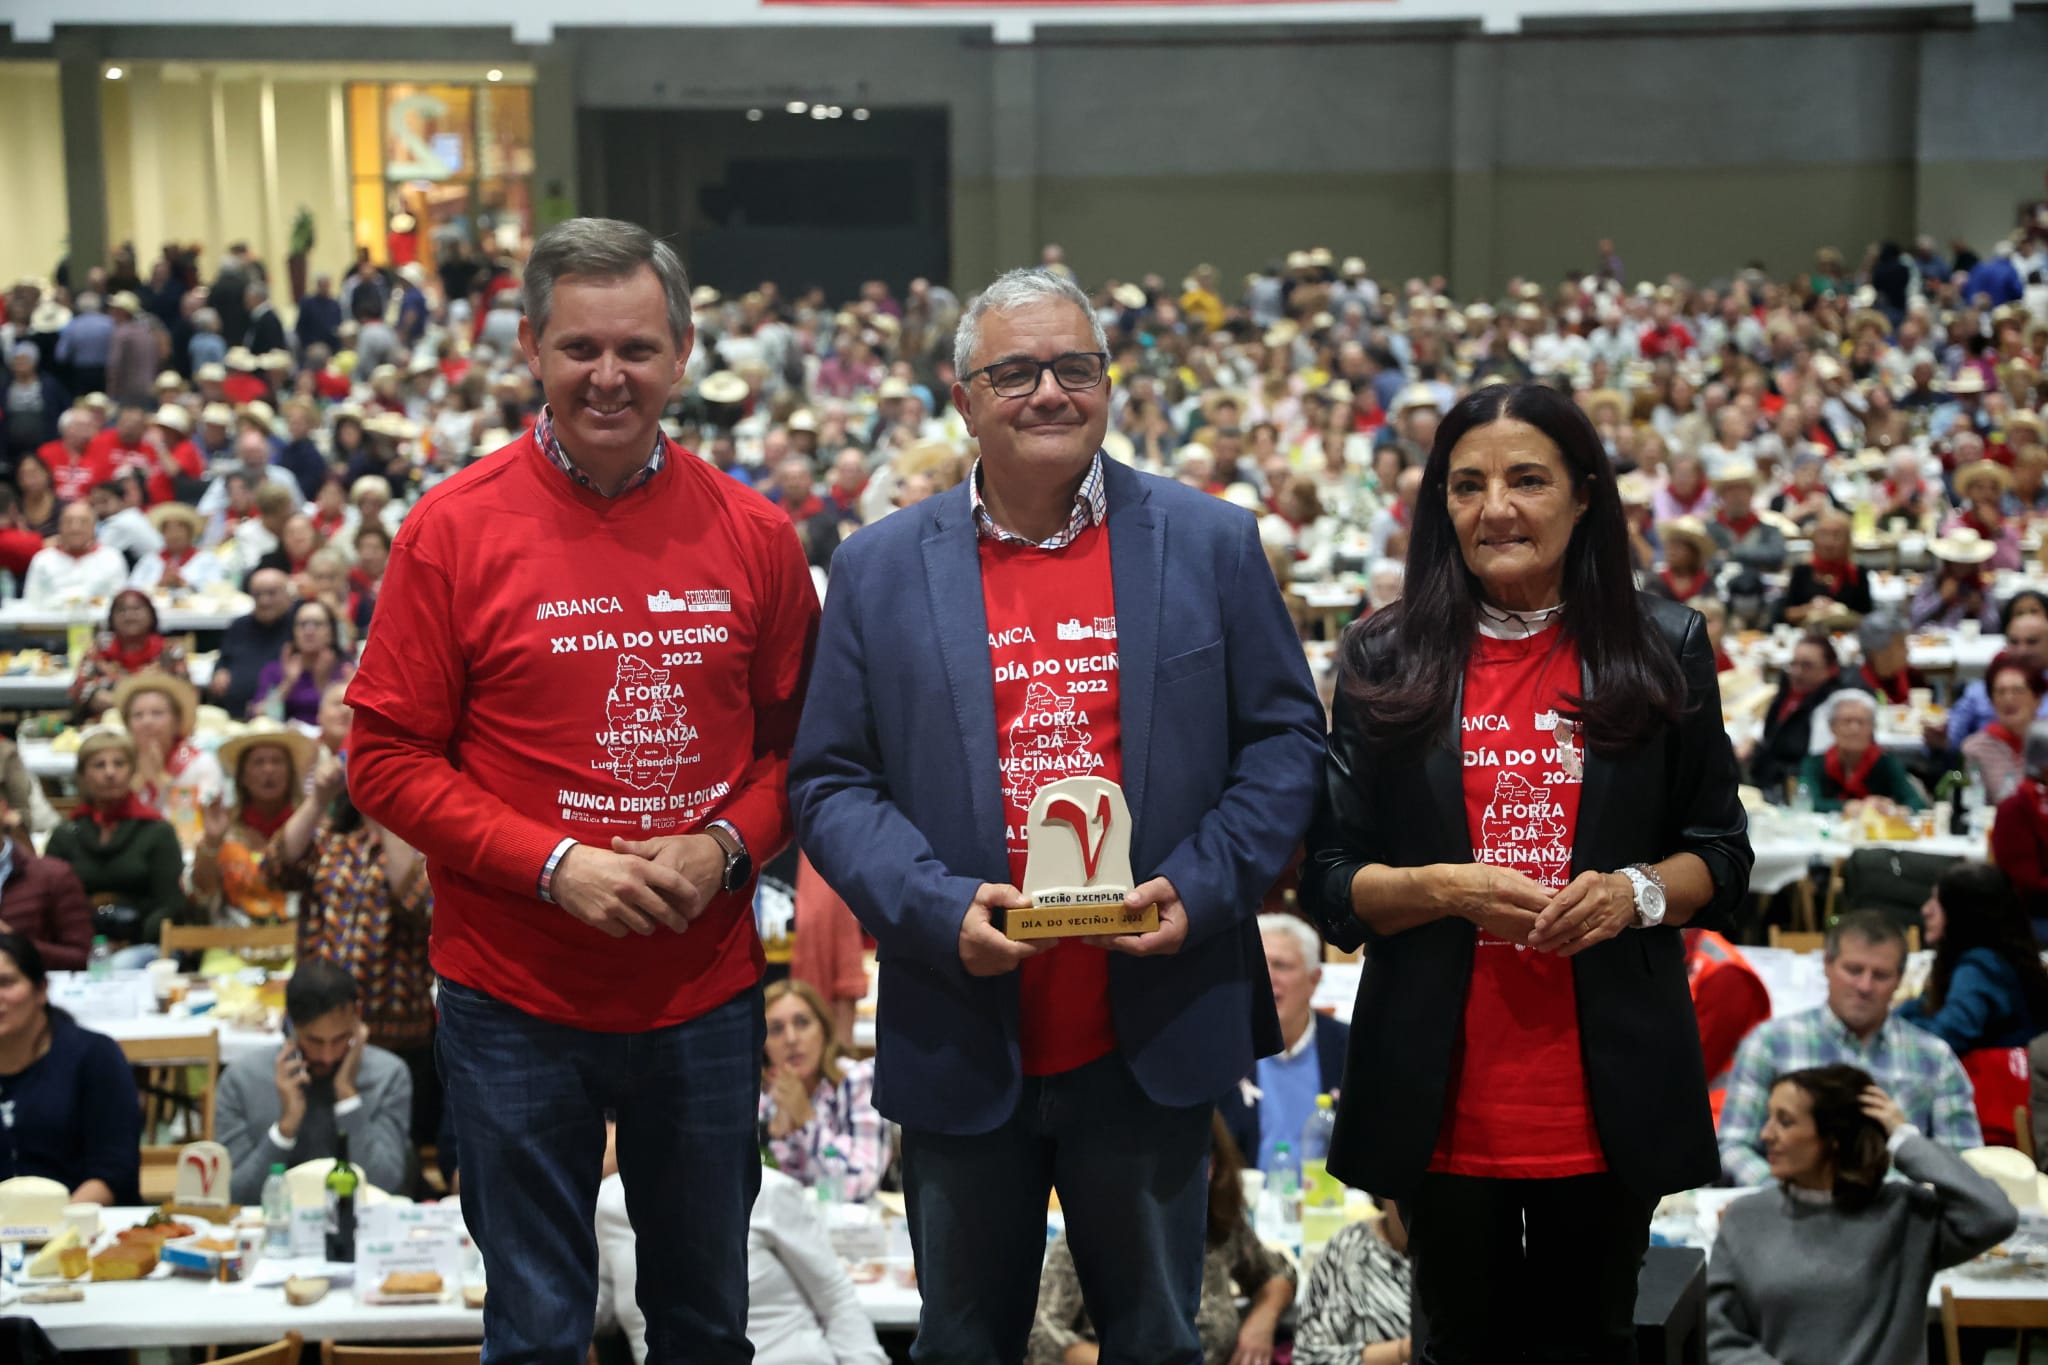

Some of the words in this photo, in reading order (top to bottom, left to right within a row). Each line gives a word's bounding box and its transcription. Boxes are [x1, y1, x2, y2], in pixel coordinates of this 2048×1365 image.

[550, 636, 579, 654] XX
[583, 630, 619, 651] DÍA
[623, 631, 653, 648] DO
[658, 624, 729, 645] VECIÑO
[988, 626, 1036, 648] ANCA
[661, 651, 703, 667] 2022
[995, 660, 1030, 683] DÍA
[1032, 658, 1061, 677] DO
[1064, 651, 1119, 674] VECIÑ
[607, 687, 620, 702] A
[624, 683, 685, 702] FORZA
[1066, 679, 1108, 694] 2022
[635, 707, 663, 722] DA
[1011, 716, 1024, 729] A
[1028, 710, 1090, 728] FORZA
[1462, 714, 1511, 731] ANCA
[622, 722, 642, 730] Lugo
[595, 725, 699, 746] VECIÑANZA
[1036, 734, 1064, 749] DA
[636, 758, 673, 768] esencia
[675, 752, 701, 765] Rural
[998, 752, 1105, 772] VECIÑANZA
[1463, 746, 1500, 767] DÍA
[1505, 749, 1537, 766] DO
[557, 788, 616, 811] ¡NUNCA
[619, 796, 667, 812] DEIXES
[669, 793, 686, 810] DE
[687, 780, 731, 807] LOITAR!
[1484, 804, 1497, 819] A
[1501, 802, 1565, 818] FORZA
[657, 820, 676, 829] LUGO
[1511, 826, 1539, 841] DA
[1497, 840, 1516, 848] Lugo
[1551, 876, 1569, 886] Rur
[1038, 893, 1071, 904] VECIÑO
[1076, 892, 1125, 902] EXEMPLAR
[1047, 919, 1063, 928] DO
